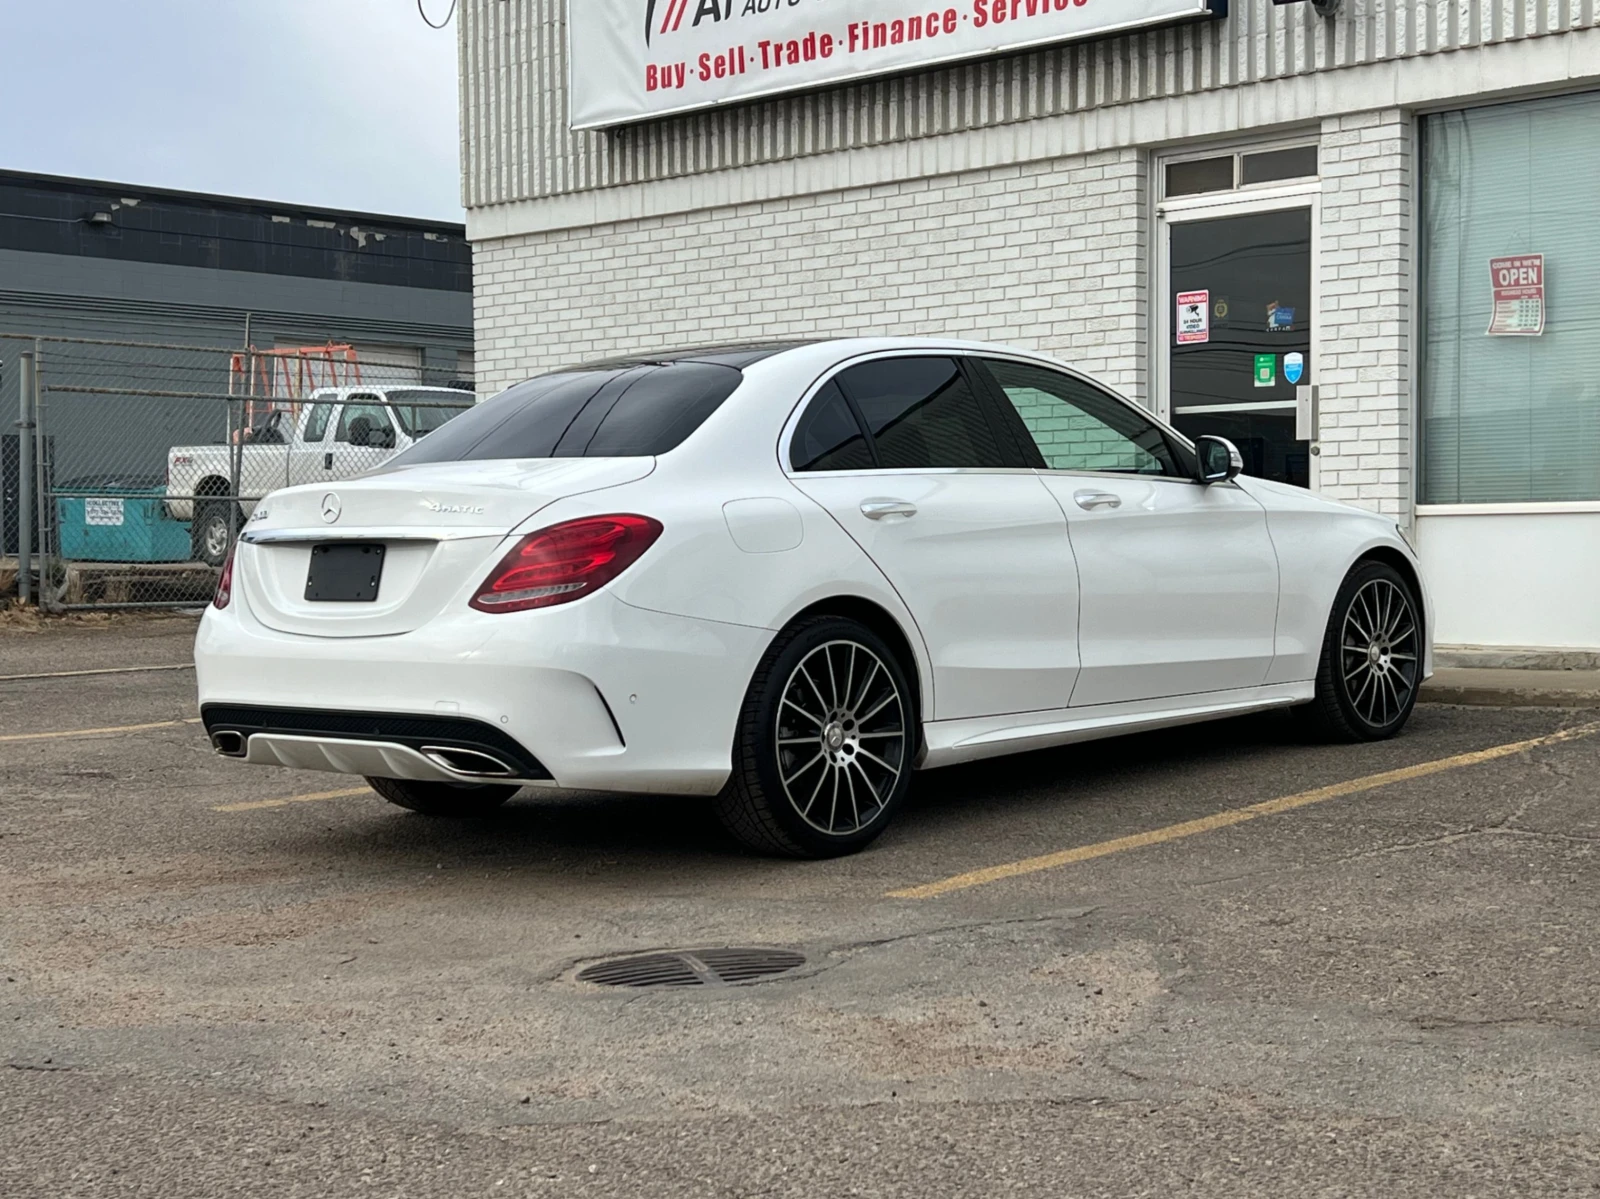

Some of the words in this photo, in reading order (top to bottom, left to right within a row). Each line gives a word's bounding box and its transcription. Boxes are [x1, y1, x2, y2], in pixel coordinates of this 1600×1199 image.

[646, 62, 685, 92] Buy
[698, 45, 746, 82] Sell
[758, 31, 833, 70] Trade
[848, 8, 957, 53] Finance
[973, 0, 1088, 28] Serv
[1499, 267, 1538, 286] OPEN
